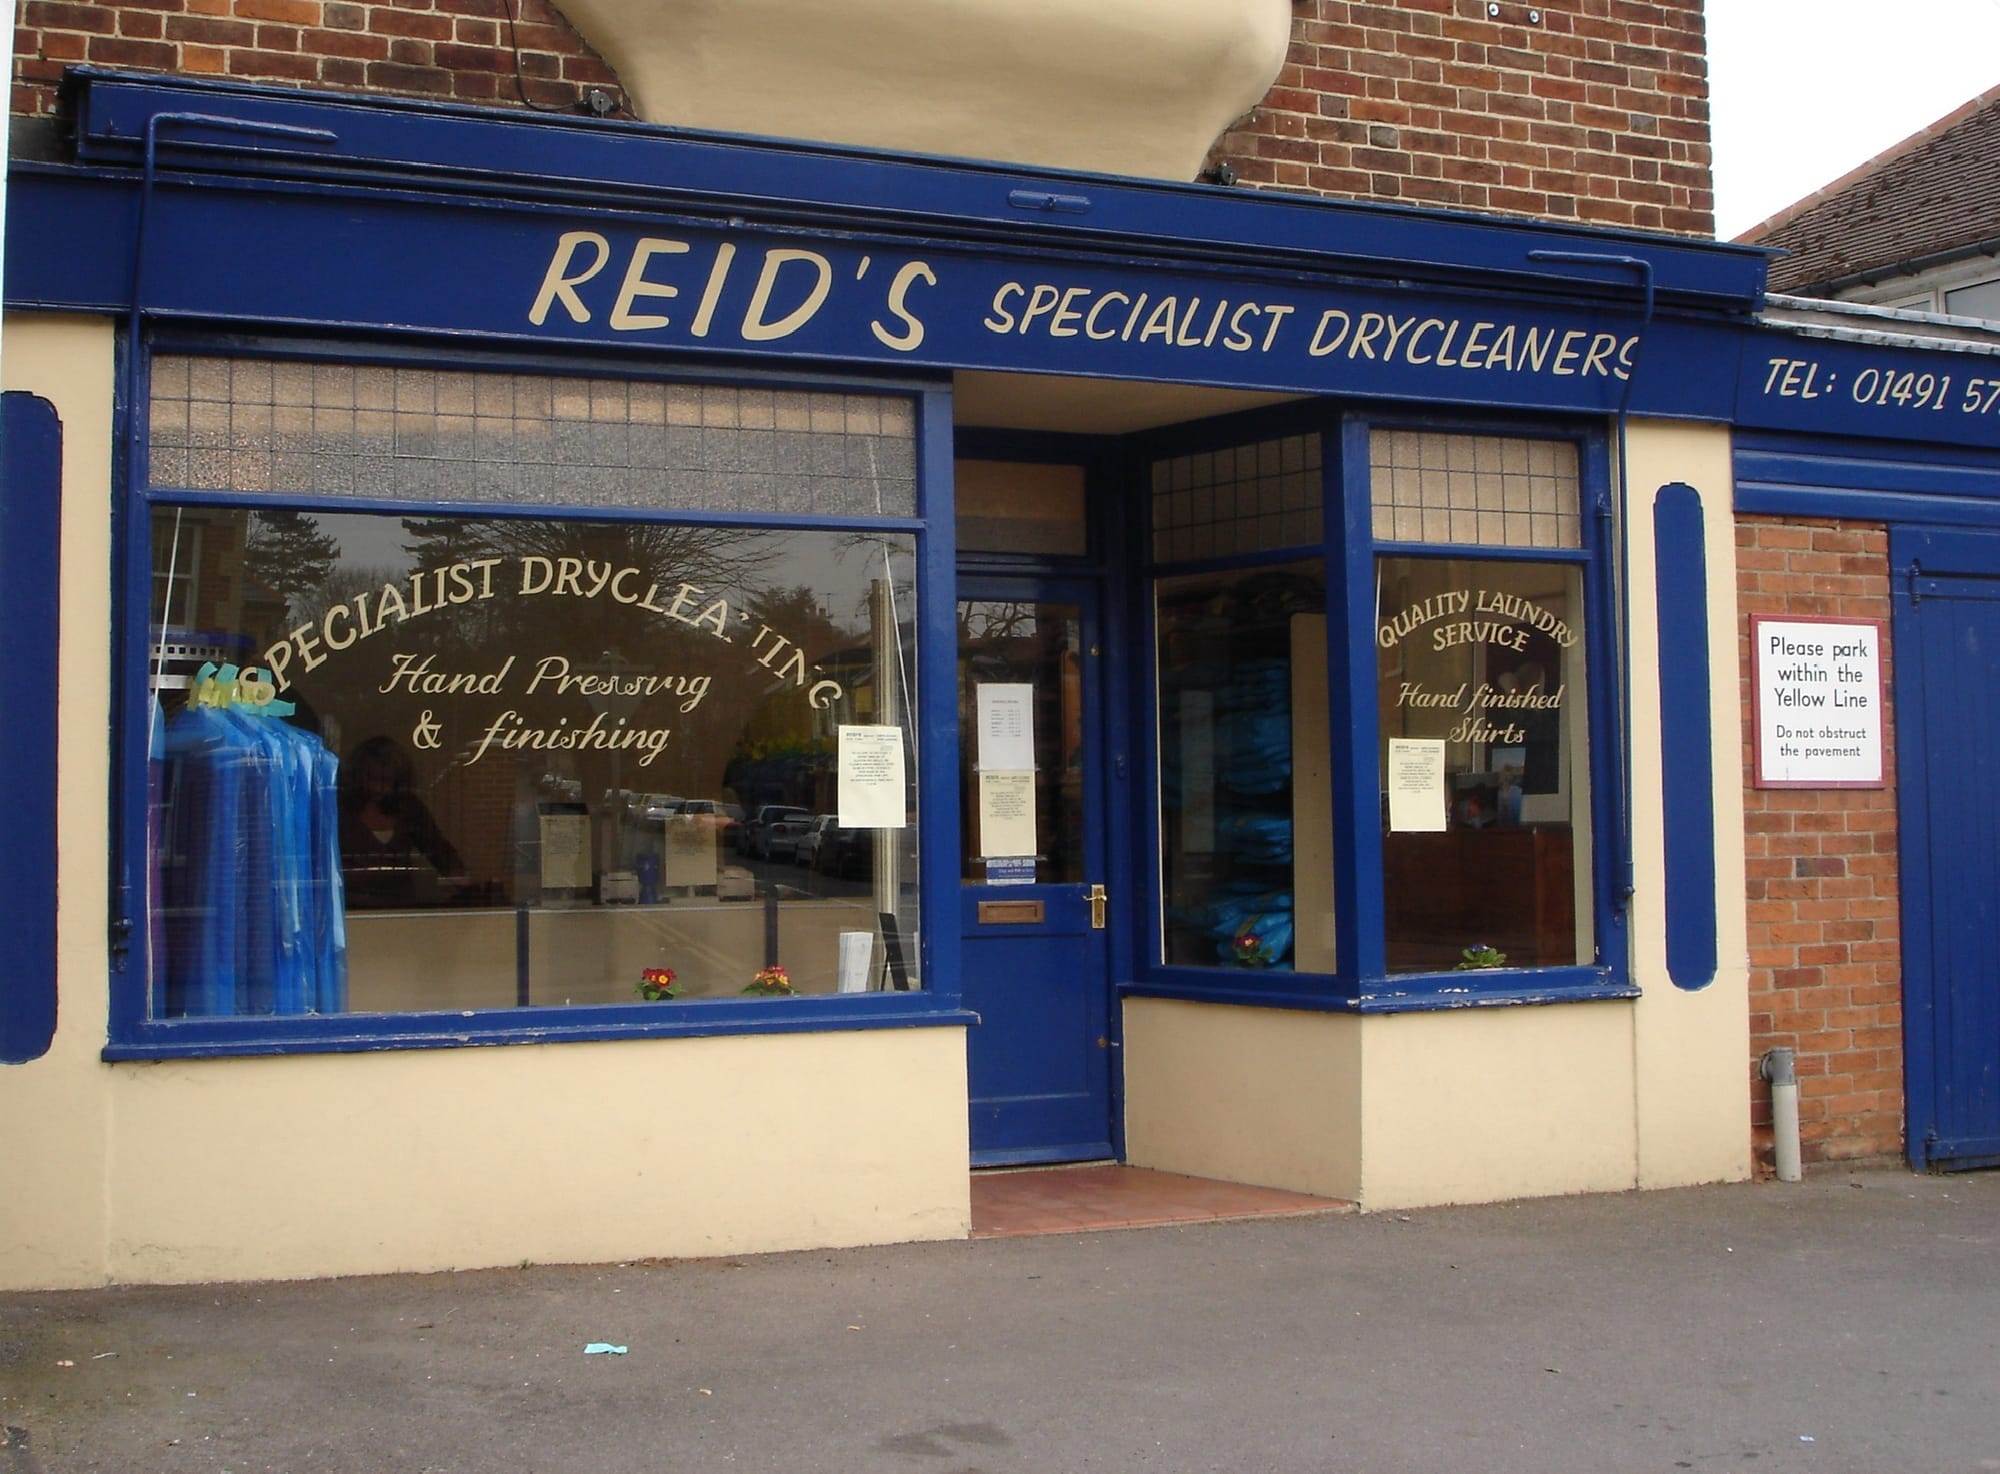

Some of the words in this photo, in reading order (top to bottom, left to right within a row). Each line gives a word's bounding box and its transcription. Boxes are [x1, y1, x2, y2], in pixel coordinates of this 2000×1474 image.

[528, 230, 937, 352] REID'S
[983, 281, 1295, 352] SPECIALIST
[1308, 309, 1640, 381] DRYCLEANERS
[1763, 357, 1837, 399] TEL:
[1852, 368, 1951, 410] 01491
[1962, 378, 2000, 415] 57
[238, 558, 502, 706] SPECIALIST
[1378, 589, 1470, 649] QUALITY
[1475, 589, 1580, 649] LAUNDRY
[1432, 621, 1531, 653] SERVICE
[1770, 636, 1824, 656] Please
[1832, 639, 1869, 661] park
[378, 653, 516, 695] Hand
[1778, 662, 1828, 682] within
[1838, 664, 1863, 683] the
[1396, 682, 1468, 709] Hand
[1462, 682, 1566, 716] finished
[1774, 687, 1826, 708] Yellow
[1833, 689, 1868, 708] Line
[412, 709, 443, 750] &
[462, 709, 671, 767] finishing
[1446, 717, 1527, 744] Shirts
[1776, 725, 1792, 739] Do
[1796, 727, 1815, 739] not
[1818, 725, 1867, 739] obstruct
[1780, 743, 1800, 757] the
[1805, 745, 1861, 759] pavement
